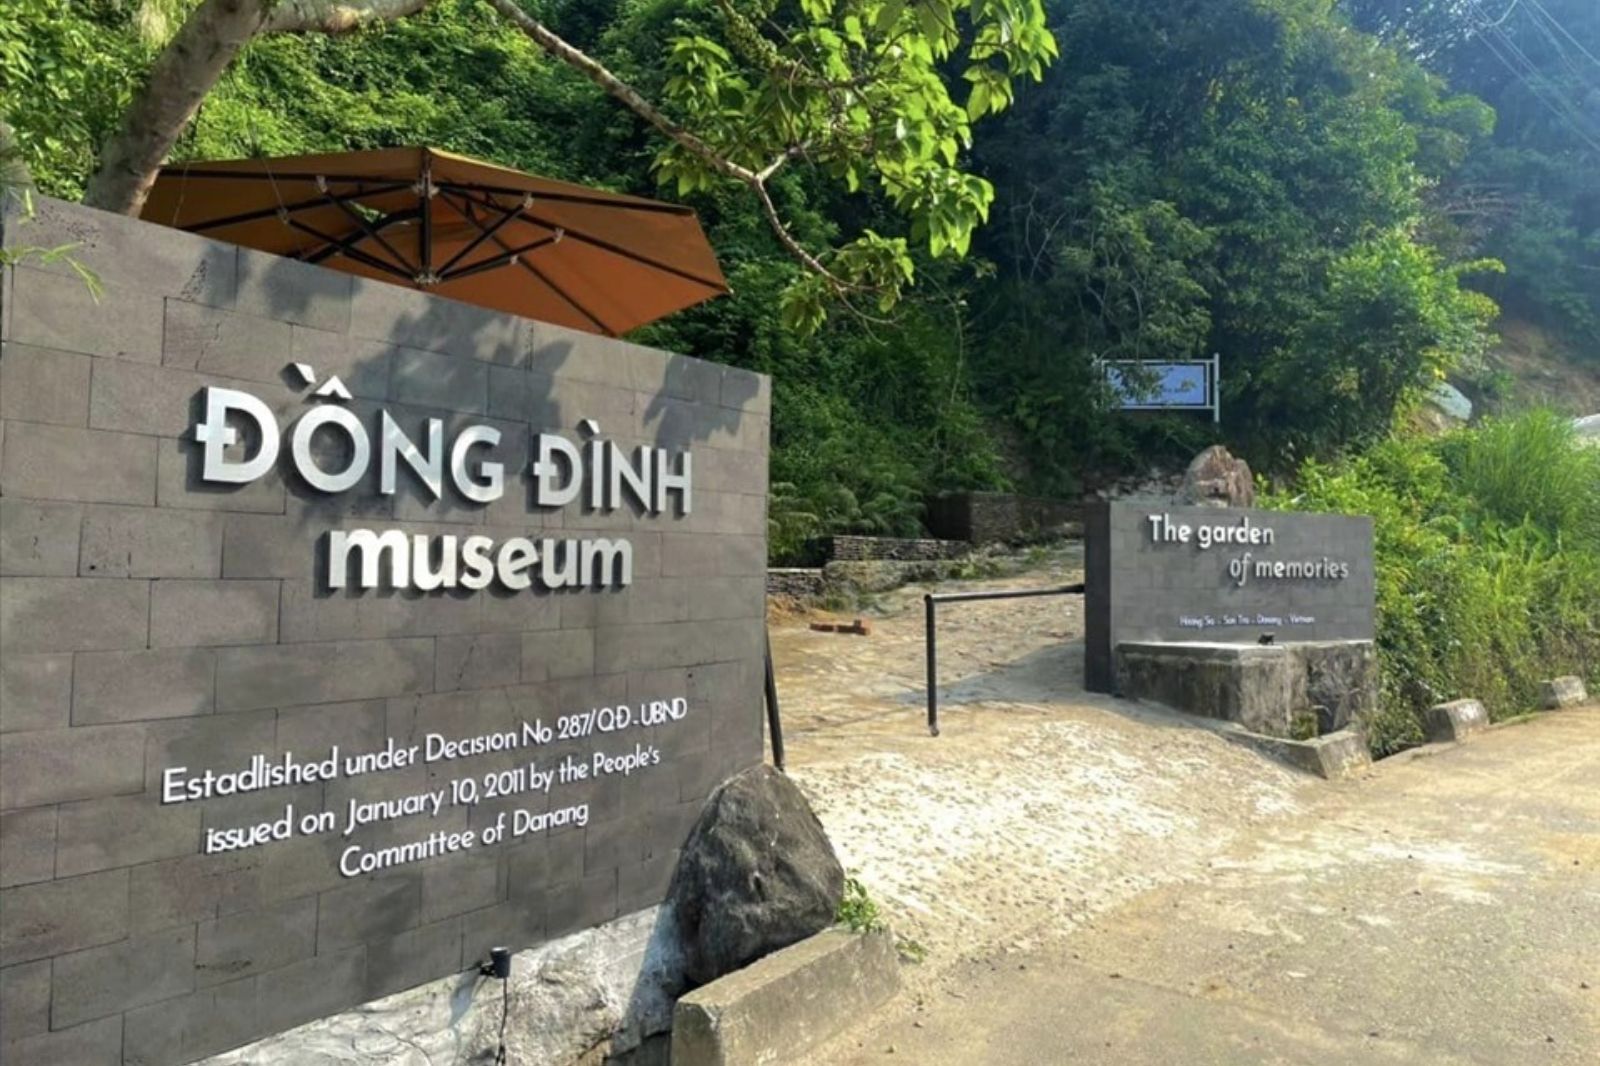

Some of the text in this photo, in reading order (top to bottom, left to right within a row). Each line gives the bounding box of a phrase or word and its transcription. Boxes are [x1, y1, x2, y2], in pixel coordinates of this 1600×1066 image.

[196, 362, 692, 513] ĐỒNG ĐÌNH
[329, 528, 632, 590] museum
[1149, 513, 1274, 548] The garden
[1256, 557, 1349, 578] memories
[345, 737, 419, 775] under
[426, 733, 517, 761] Decision
[523, 719, 552, 746] No
[206, 744, 660, 853] issued on January 10, 2011 by the People's
[340, 804, 589, 877] Committee of Danang
